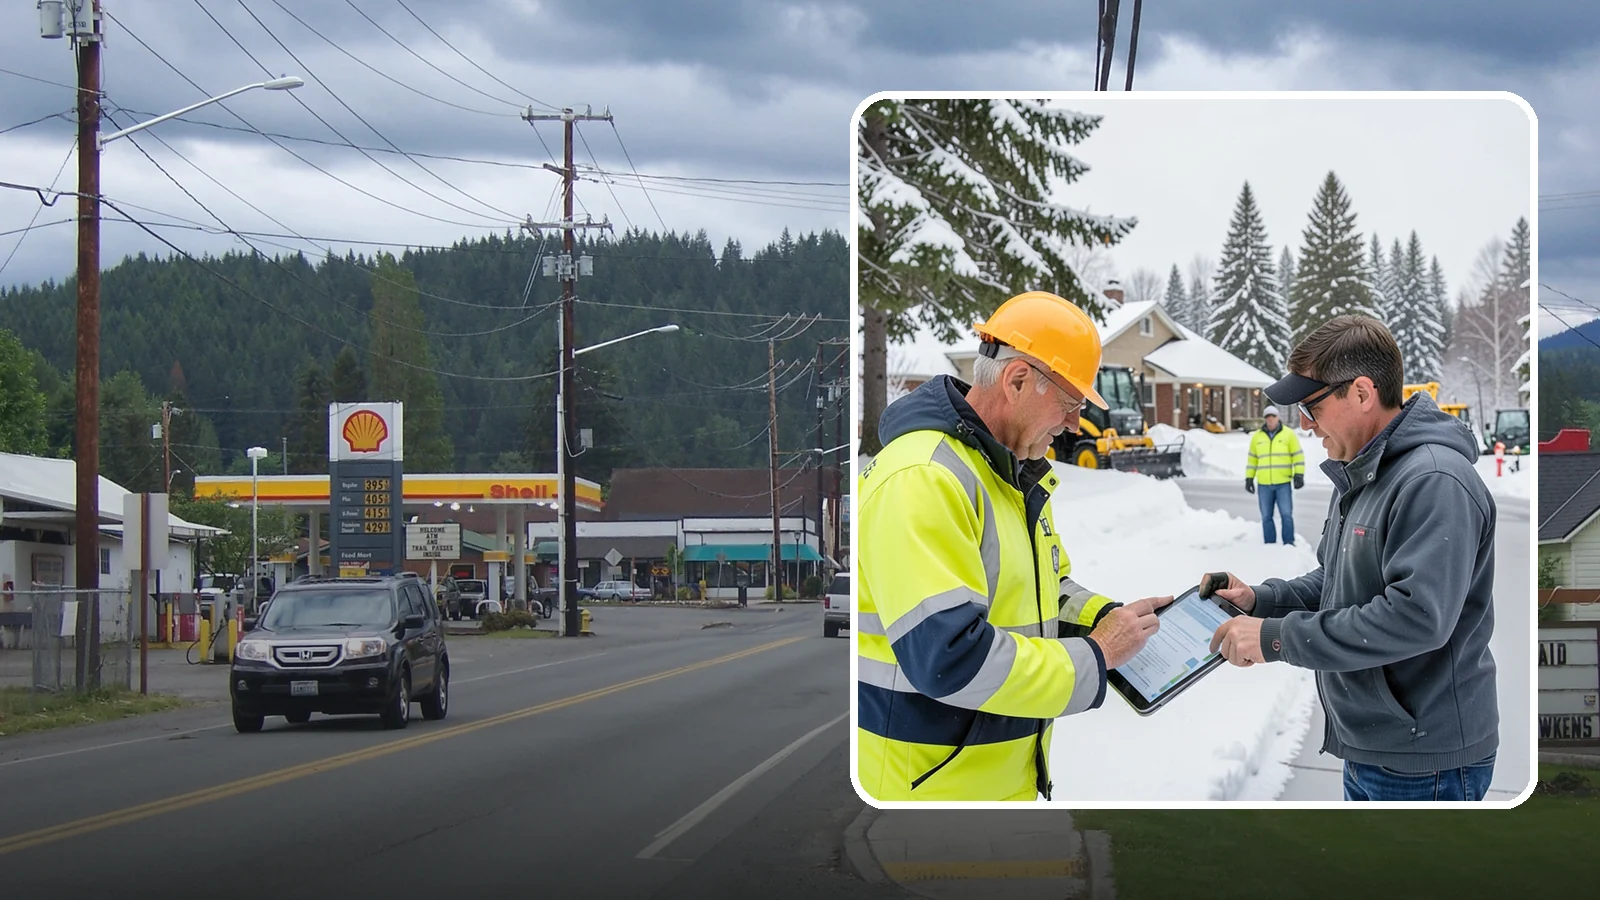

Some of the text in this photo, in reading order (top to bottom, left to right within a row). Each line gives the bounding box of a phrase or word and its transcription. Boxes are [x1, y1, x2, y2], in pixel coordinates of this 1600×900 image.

[365, 480, 383, 490] 395
[490, 484, 547, 499] Shell
[365, 494, 383, 504] 405
[365, 508, 383, 518] 415
[365, 522, 383, 533] 429
[1538, 716, 1592, 738] WKENS
